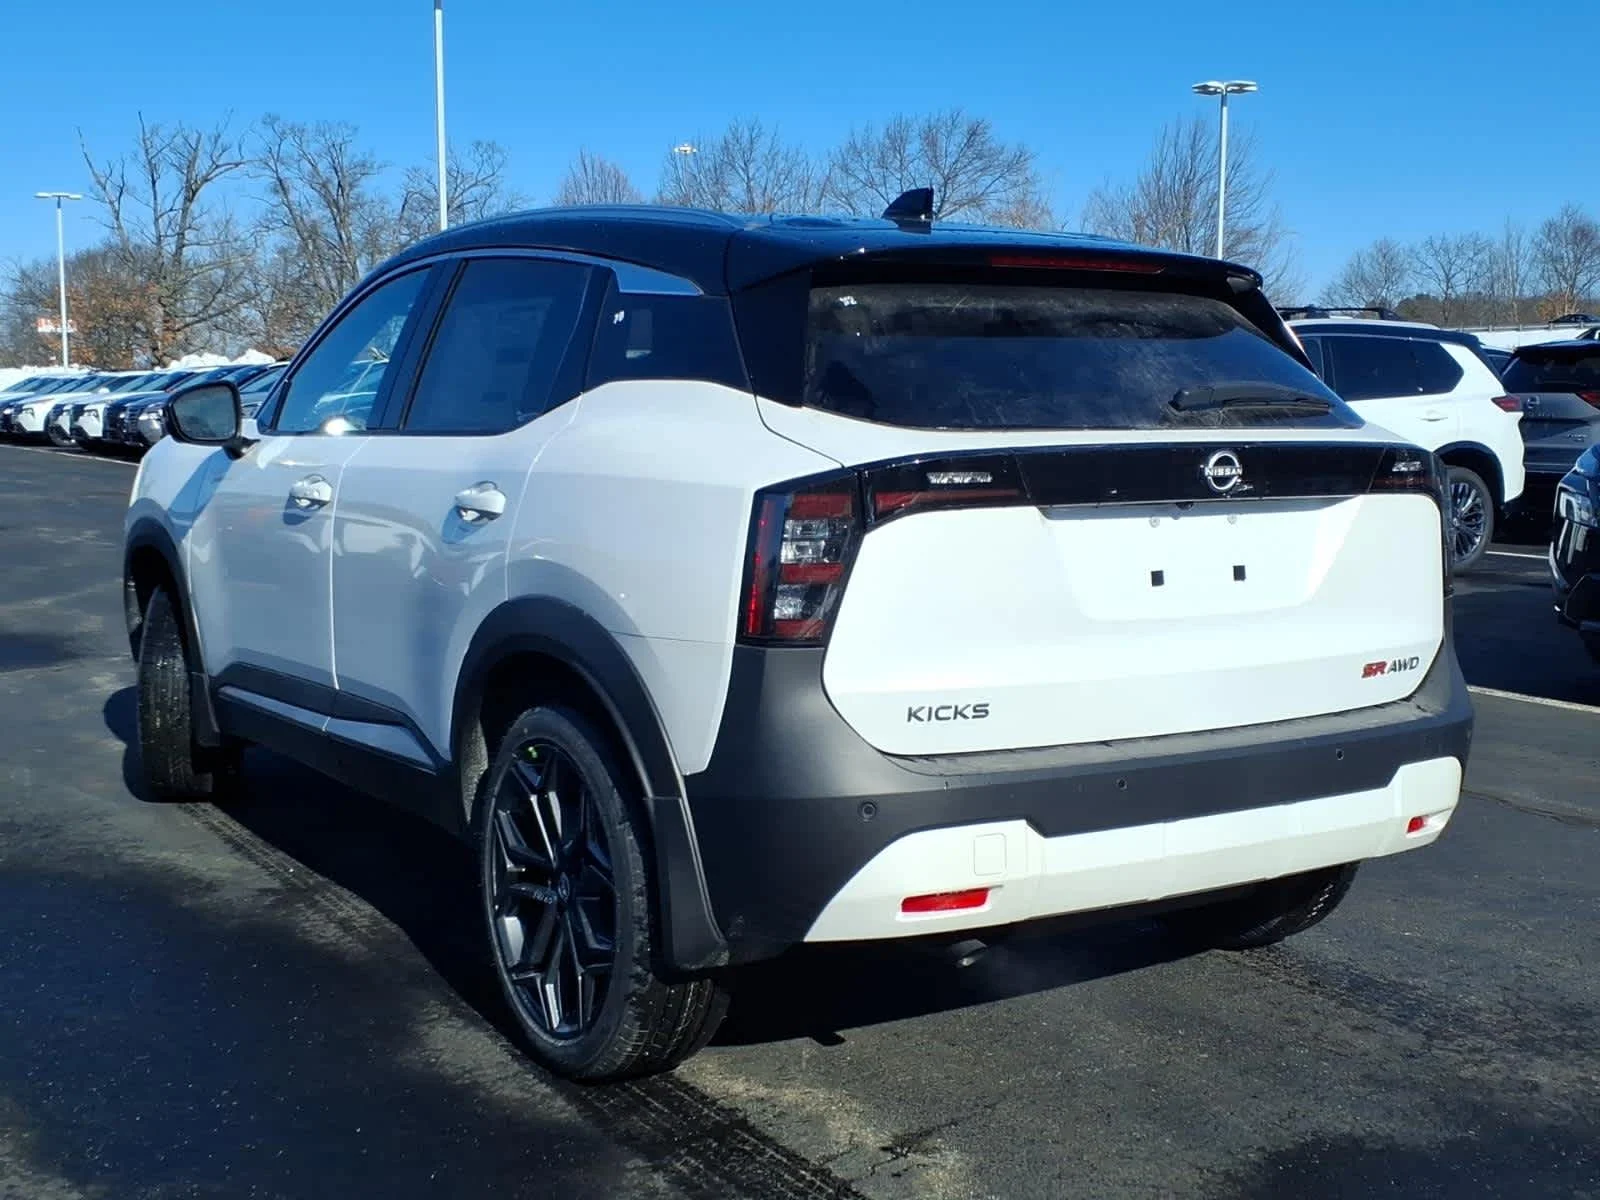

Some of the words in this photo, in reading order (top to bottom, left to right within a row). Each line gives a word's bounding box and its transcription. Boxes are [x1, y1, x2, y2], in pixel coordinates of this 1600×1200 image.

[1204, 466, 1242, 477] NISSAN
[1361, 661, 1387, 678] SR
[1387, 656, 1419, 674] AWD
[907, 703, 989, 722] KICKS
